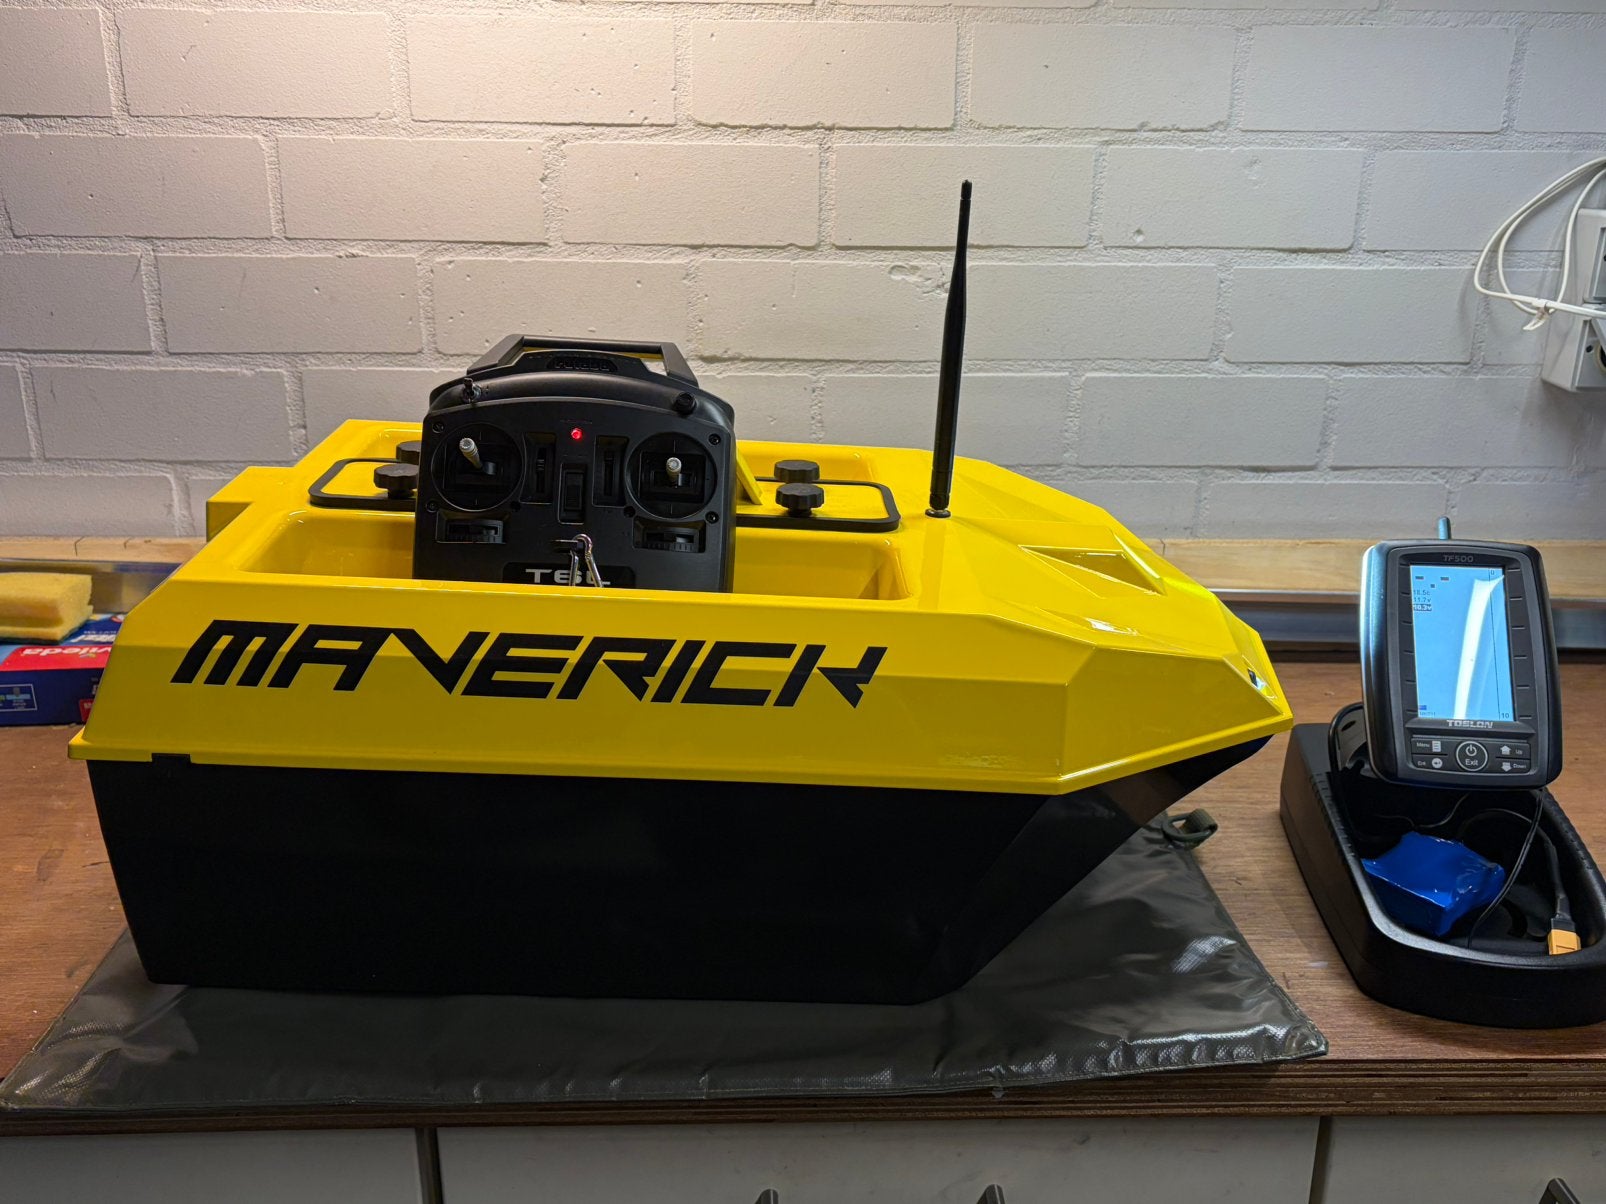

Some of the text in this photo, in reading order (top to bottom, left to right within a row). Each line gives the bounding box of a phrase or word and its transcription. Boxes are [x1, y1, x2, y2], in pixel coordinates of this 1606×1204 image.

[1443, 555, 1474, 563] TF500
[22, 646, 111, 657] vileda
[170, 619, 887, 709] MAVERICK
[1447, 719, 1494, 729] TOSLON
[1465, 758, 1479, 766] Exit
